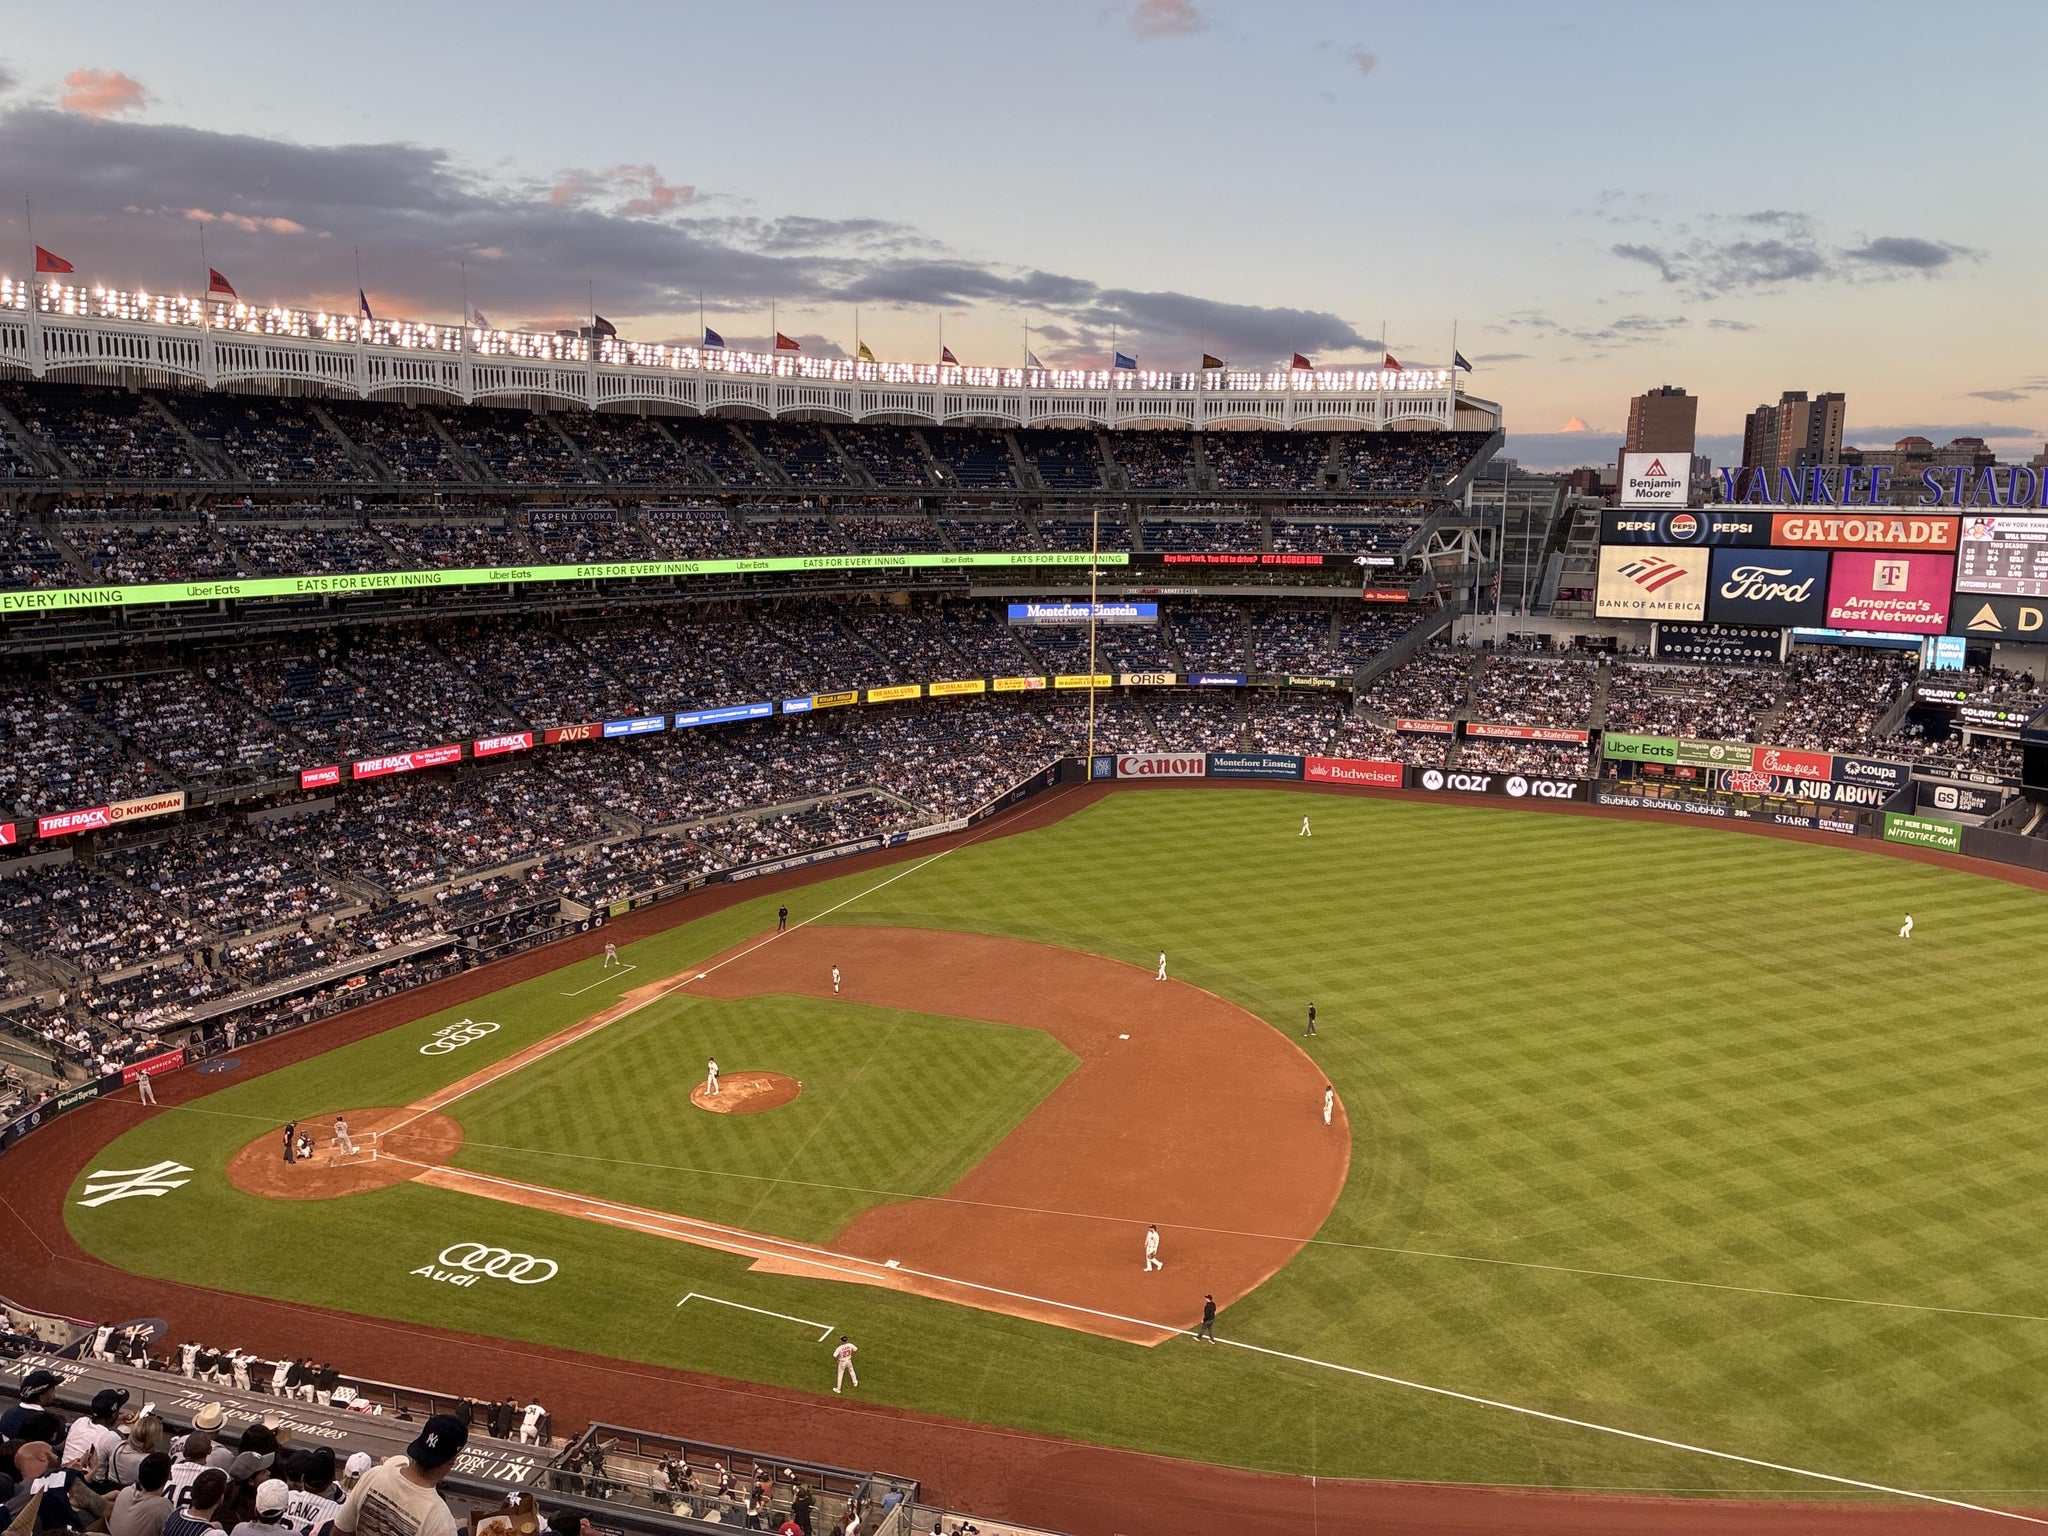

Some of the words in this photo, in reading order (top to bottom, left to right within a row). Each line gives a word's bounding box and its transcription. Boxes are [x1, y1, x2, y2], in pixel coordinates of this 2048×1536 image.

[1630, 478, 1681, 490] Benjamin
[1718, 465, 1894, 506] YANKEE
[1635, 489, 1671, 498] Moore
[533, 512, 568, 521] ASPEN
[580, 512, 613, 520] VODKA
[652, 512, 684, 520] ASPEN
[692, 512, 722, 520] VODKA
[1617, 521, 1656, 532] PEPSI
[1672, 522, 1696, 530] PEPSI
[1712, 522, 1753, 534] PEPSI
[1783, 519, 1949, 544] GATORADE
[803, 558, 824, 568] EATS
[825, 558, 843, 567] FOR
[844, 558, 872, 567] EVERY
[874, 557, 905, 566] INNING
[941, 556, 958, 564] Uber
[1011, 555, 1033, 563] EATS
[1036, 555, 1054, 563] FOR
[1056, 555, 1085, 563] EVERY
[1261, 555, 1275, 564] GET
[1275, 555, 1282, 564] A
[1281, 555, 1306, 564] SOBER
[1306, 556, 1323, 564] RIDE
[577, 566, 603, 577] EATS
[606, 565, 627, 576] FOR
[630, 564, 661, 575] EVERY
[664, 563, 699, 573] INNING
[736, 561, 753, 570] Uber
[753, 561, 769, 569] Eats
[296, 578, 329, 592] EATS
[332, 577, 357, 590] FOR
[360, 575, 398, 589] EVERY
[401, 573, 442, 586] INNING
[488, 570, 509, 580] Uber
[511, 570, 532, 579] Eats
[1720, 565, 1816, 603] Ford
[4, 593, 57, 609] EVERY
[63, 590, 123, 605] INNING
[186, 586, 213, 597] Uber
[215, 585, 241, 595] Eats
[1844, 596, 1932, 612] America's
[1027, 604, 1089, 617] Montefiore
[1091, 604, 1138, 617] Einstein
[1599, 600, 1629, 608] BANK
[1632, 600, 1647, 609] OF
[1649, 601, 1702, 611] AMERICA
[1830, 607, 1867, 621] Best
[1870, 610, 1945, 625] Network
[2017, 606, 2044, 632] D
[1130, 674, 1165, 684] ORIS
[1289, 677, 1312, 686] Poland
[1312, 677, 1337, 688] Spring
[1918, 688, 1957, 699] COLONY
[1960, 707, 1998, 718] COLONY
[559, 727, 590, 741] AVIS
[478, 740, 499, 752] TIRE
[500, 734, 528, 748] RACK
[1607, 741, 1640, 754] Uber
[1641, 744, 1675, 757] Eats
[357, 757, 383, 774] TIRE
[383, 754, 415, 770] RACK
[1118, 756, 1204, 776] Canon
[1214, 757, 1261, 767] Montefiore
[1263, 758, 1297, 769] Einstein
[303, 774, 319, 783] TIRE
[318, 771, 338, 781] RACK
[1728, 770, 1772, 784] Jersey
[1861, 764, 1897, 779] coupa
[1930, 769, 1949, 777] WATCH
[1447, 774, 1491, 792] razr
[1531, 780, 1577, 798] razr
[1784, 778, 1795, 795] A
[1800, 780, 1831, 801] SUB
[1834, 784, 1888, 806] ABOVE
[1938, 792, 1955, 804] GS
[126, 798, 181, 816] KIKKOMAN
[1600, 795, 1639, 807] StubHub
[1642, 799, 1682, 812] StubHub
[1684, 803, 1725, 816] StubHub
[1734, 809, 1747, 817] 399
[41, 817, 71, 831] TIRE
[71, 810, 108, 825] RACK
[1774, 814, 1810, 827] STARR
[1819, 819, 1854, 831] CUTWATER
[1893, 818, 1904, 826] HIT
[1921, 823, 1933, 831] FOR
[1933, 825, 1954, 835] TRIPLE
[1888, 827, 1957, 848] NITTOTIRE.COM
[431, 1018, 474, 1038] Audi
[57, 1093, 78, 1110] Poland
[78, 1087, 98, 1101] Spring
[409, 1264, 481, 1288] Audi
[842, 1350, 851, 1358] 23
[170, 1389, 205, 1412] New
[528, 1406, 537, 1416] 34
[426, 1432, 439, 1448] NY
[288, 1500, 320, 1521] CANO
